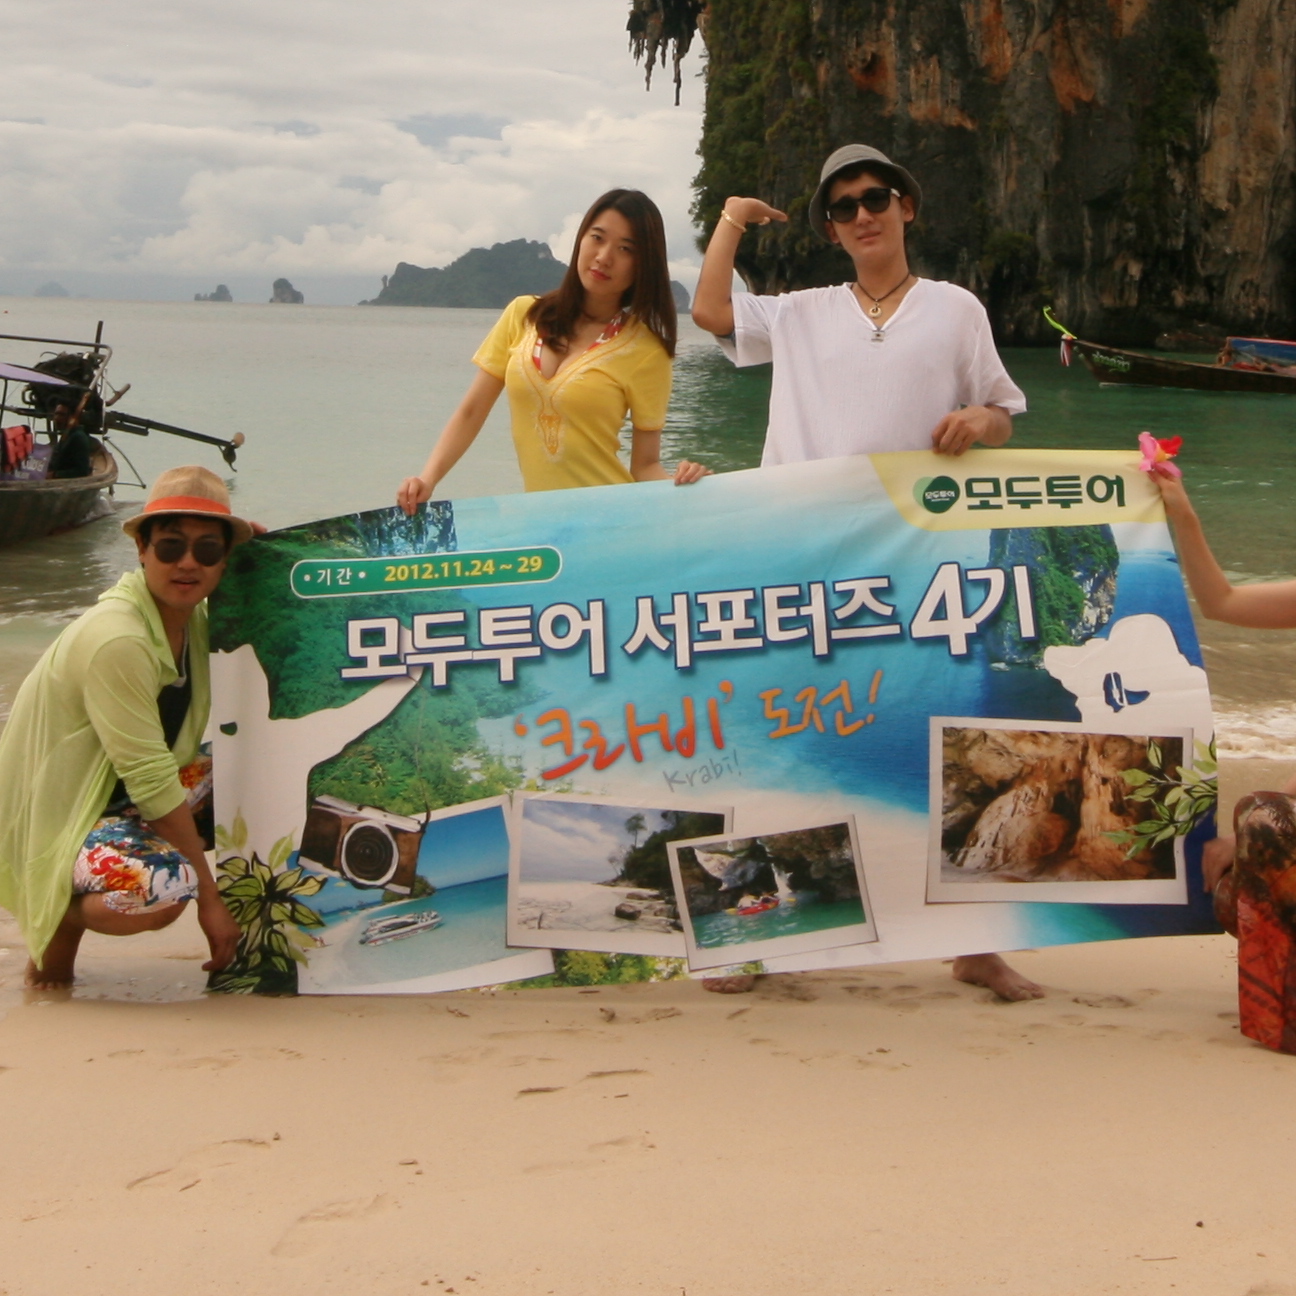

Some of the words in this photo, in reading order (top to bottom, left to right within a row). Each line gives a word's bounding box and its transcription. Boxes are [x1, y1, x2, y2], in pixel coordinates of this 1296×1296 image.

[965, 474, 1126, 510] 모두투어
[316, 567, 352, 586] 기간
[384, 559, 495, 582] 2012.11.24
[339, 599, 606, 688] 모두투어
[621, 574, 903, 670] 서포터즈
[908, 561, 1038, 657] 4기
[759, 669, 883, 738] 도전!
